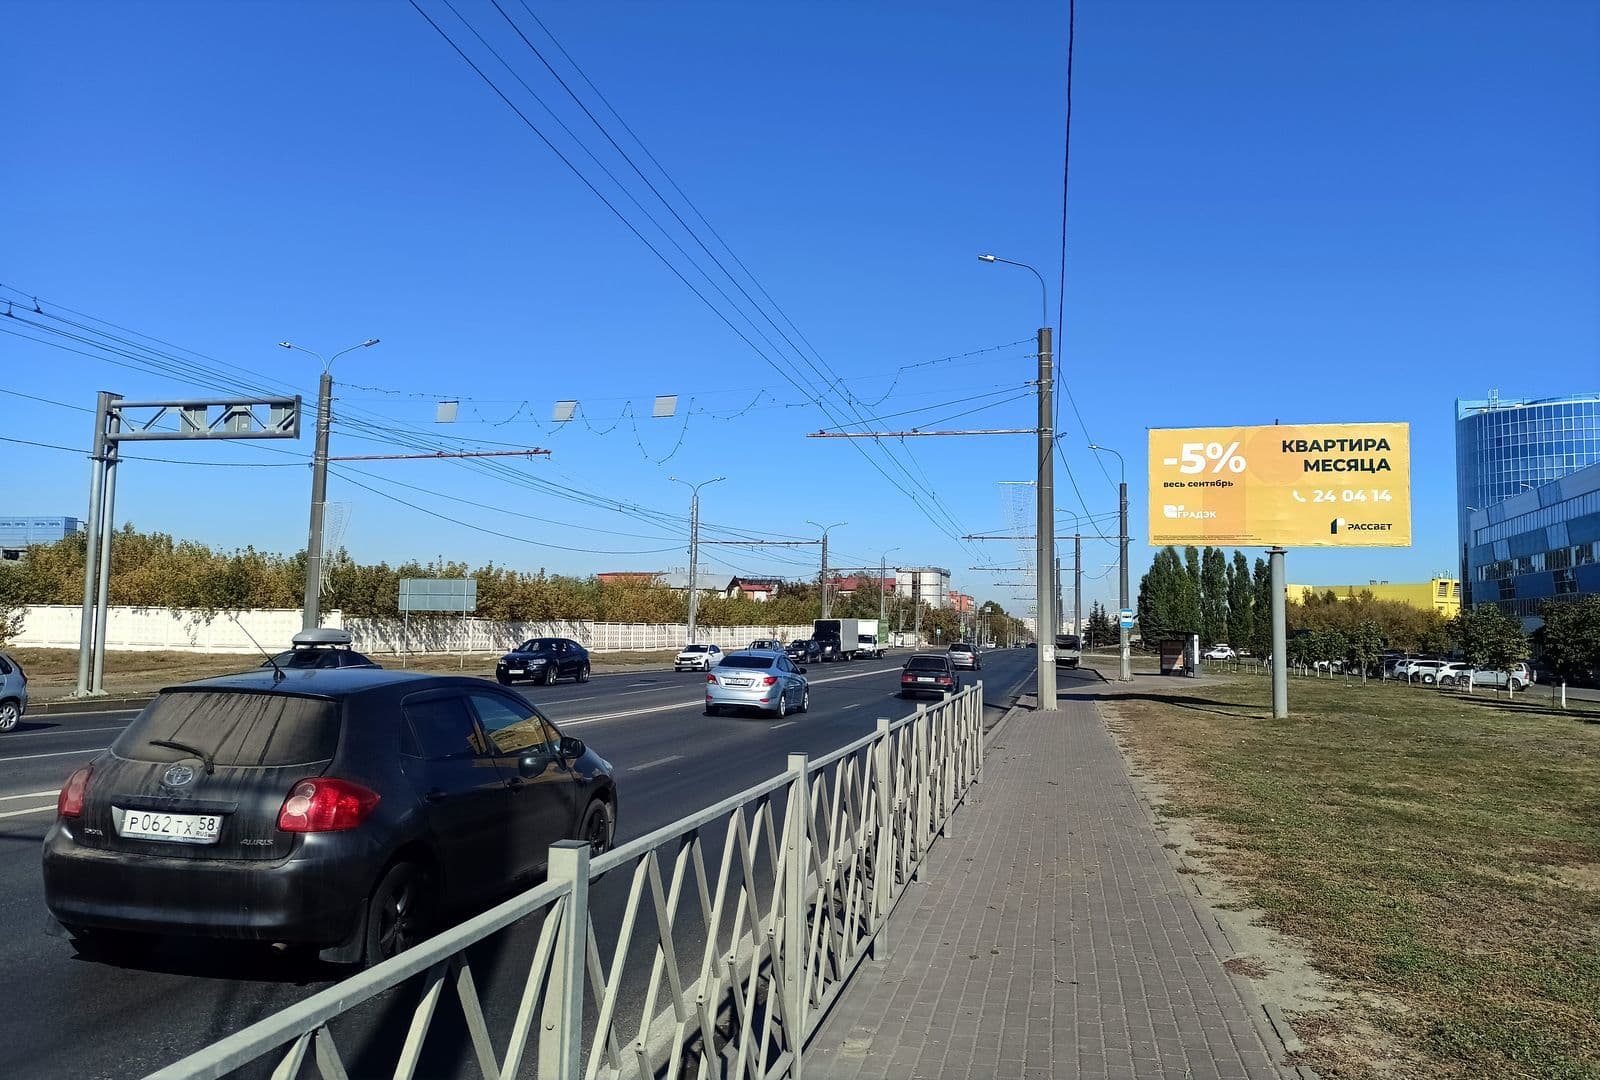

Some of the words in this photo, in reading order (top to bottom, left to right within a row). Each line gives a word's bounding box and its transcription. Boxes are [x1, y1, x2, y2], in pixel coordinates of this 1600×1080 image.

[1281, 438, 1391, 453] КВАРТИРА
[1163, 441, 1247, 474] -5%
[1303, 458, 1391, 474] МЕСЯЦА
[1187, 479, 1234, 488] сентябрь
[1312, 489, 1337, 503] 24
[1342, 489, 1367, 502] 04
[1371, 488, 1392, 502] 14
[1177, 511, 1217, 519] ГРАДЭК
[1347, 523, 1392, 531] РАССВЕТ
[199, 817, 215, 831] 58
